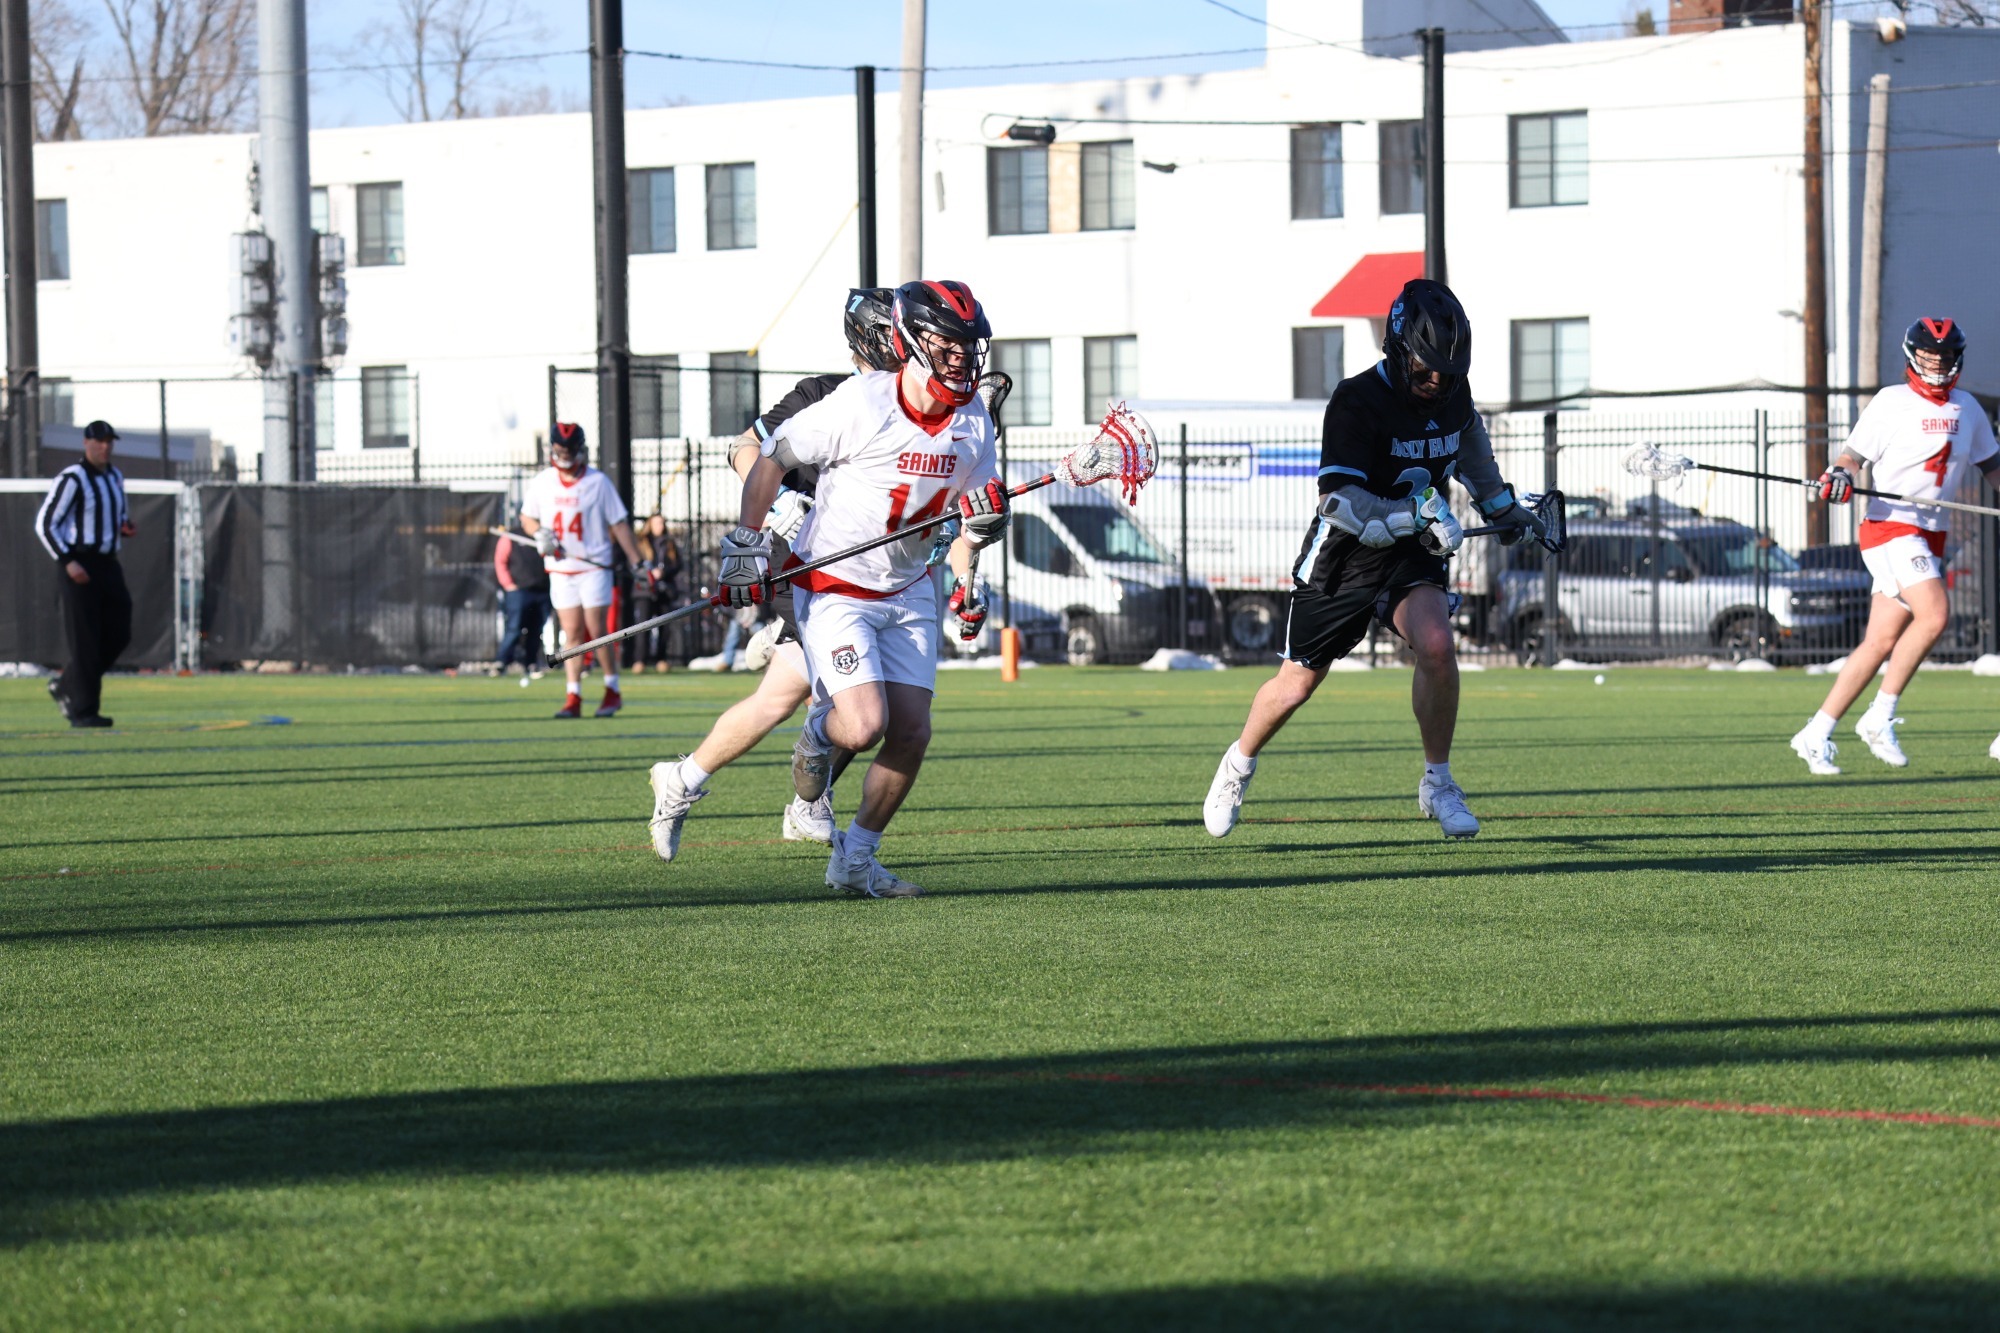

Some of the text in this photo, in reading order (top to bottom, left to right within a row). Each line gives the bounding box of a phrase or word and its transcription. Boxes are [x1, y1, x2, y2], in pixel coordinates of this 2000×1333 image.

[848, 294, 864, 313] 7
[1390, 437, 1425, 459] HOLY
[1924, 440, 1953, 488] 4
[552, 511, 584, 543] 44
[886, 483, 952, 542] 14
